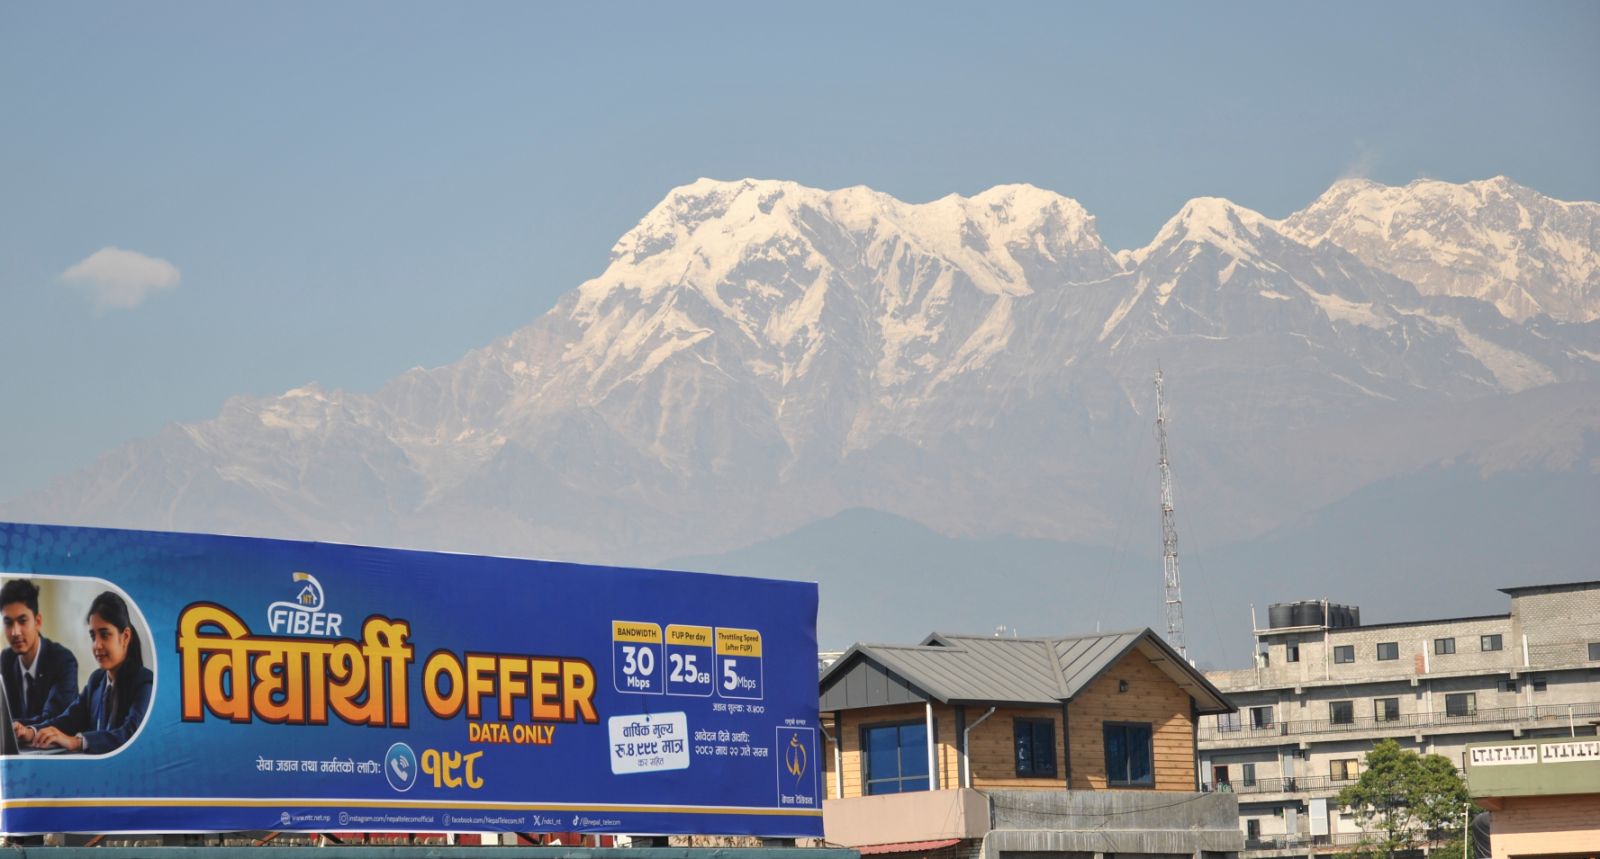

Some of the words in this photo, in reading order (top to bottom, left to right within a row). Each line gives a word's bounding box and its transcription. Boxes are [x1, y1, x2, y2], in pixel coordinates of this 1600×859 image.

[271, 610, 342, 636] FIBER
[617, 628, 657, 638] BANDWIDTH
[671, 632, 684, 640] FUP
[695, 634, 706, 642] day
[718, 633, 743, 642] Throttling
[743, 634, 759, 643] Speed
[725, 642, 738, 652] (after
[739, 644, 753, 653] FUP)
[177, 601, 415, 728] विद्यार्थी
[421, 648, 600, 725] OFFER
[622, 645, 655, 676] 30
[627, 676, 650, 691] Mbps
[468, 722, 511, 743] DATA
[512, 723, 555, 745] ONLY
[623, 722, 650, 738] वार्षिक
[694, 728, 716, 741] आवेदन
[661, 739, 684, 754] मात्र
[695, 745, 714, 755] २०८२
[256, 755, 273, 772] सेवा
[275, 759, 298, 772] जडान
[301, 759, 318, 772] तथा
[320, 757, 354, 773] मर्मतको
[420, 748, 484, 789] १९८
